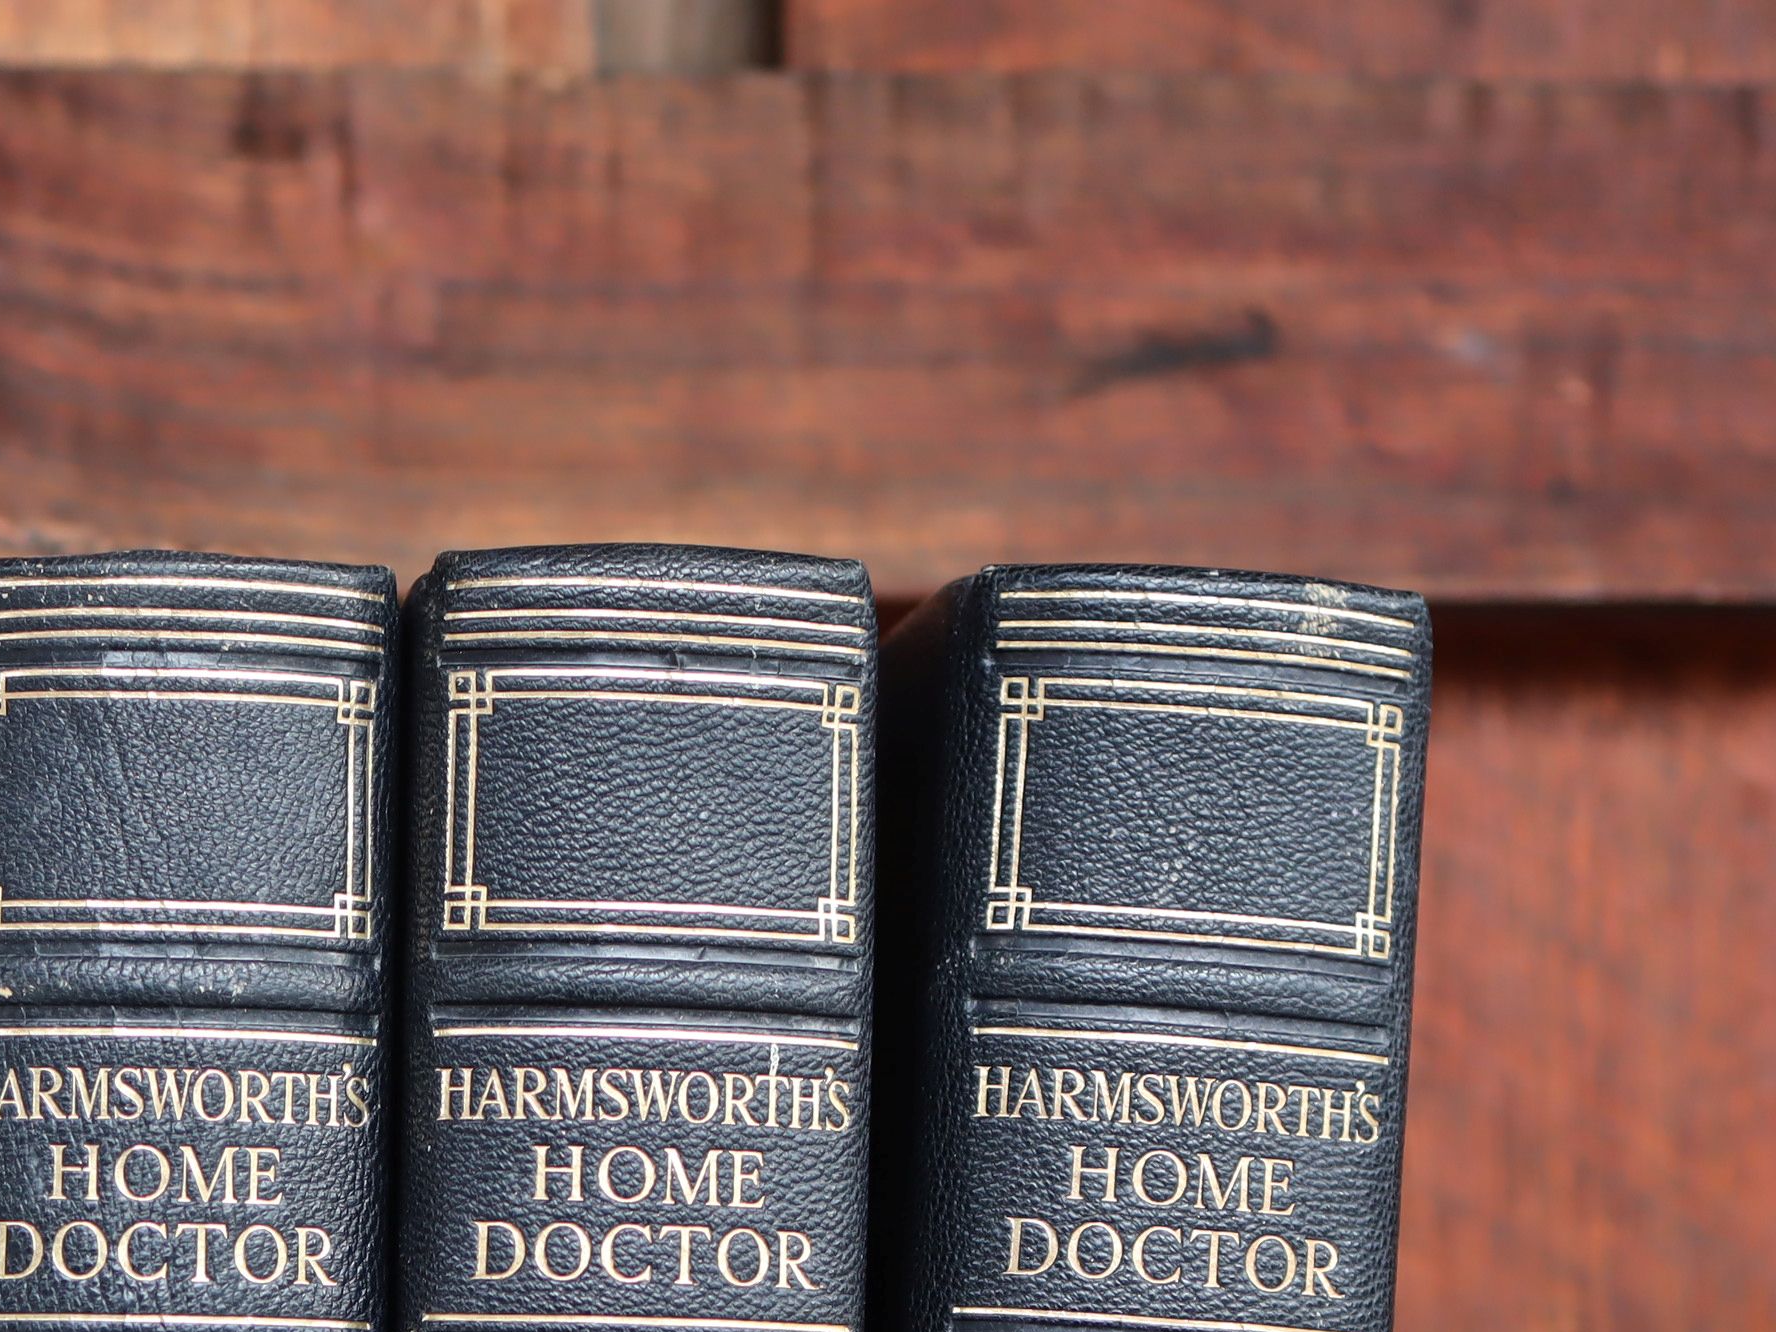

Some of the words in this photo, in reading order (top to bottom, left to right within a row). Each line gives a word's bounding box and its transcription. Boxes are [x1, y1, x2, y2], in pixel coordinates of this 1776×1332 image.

[435, 1067, 853, 1133] HARMSWORTH'S
[971, 1065, 1382, 1145] HARMSWORTH'S
[48, 1143, 284, 1206] HOME
[530, 1144, 767, 1209] HOME
[1065, 1145, 1296, 1217] HOME
[469, 1220, 825, 1291] DOCTOR
[1003, 1215, 1347, 1300] DOCTOR
